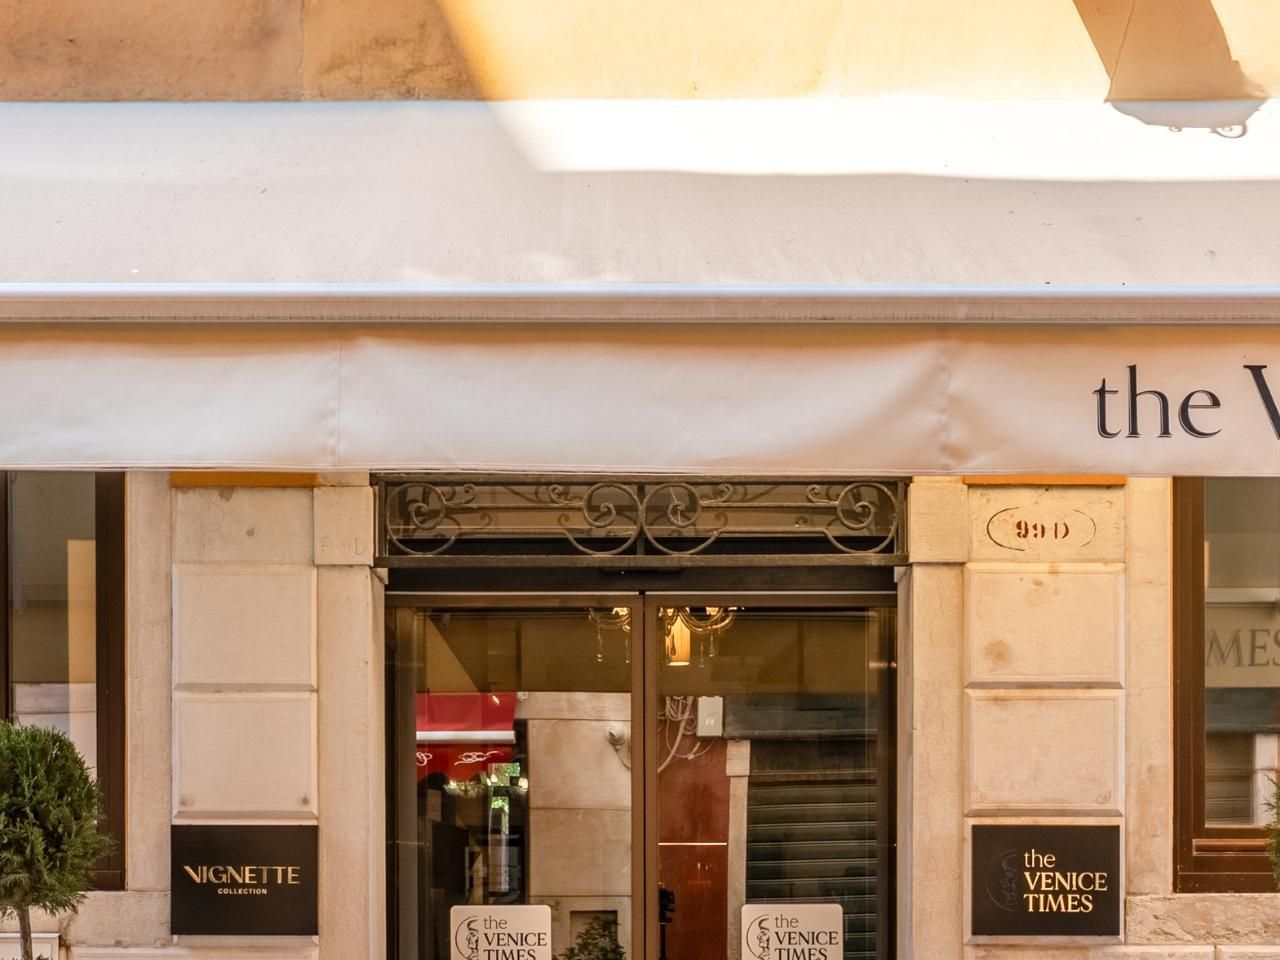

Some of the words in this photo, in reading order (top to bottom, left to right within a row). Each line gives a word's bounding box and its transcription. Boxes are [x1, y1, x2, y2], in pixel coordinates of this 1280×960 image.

[1093, 365, 1222, 440] the
[1023, 848, 1056, 868] the
[183, 865, 301, 884] VIGNETTE
[1023, 871, 1108, 891] VENICE
[217, 887, 268, 895] COLLECTION
[1023, 893, 1094, 913] TIMES
[483, 915, 508, 930] the
[774, 913, 799, 929] the
[483, 932, 548, 947] VENICE
[774, 930, 839, 945] VENICE
